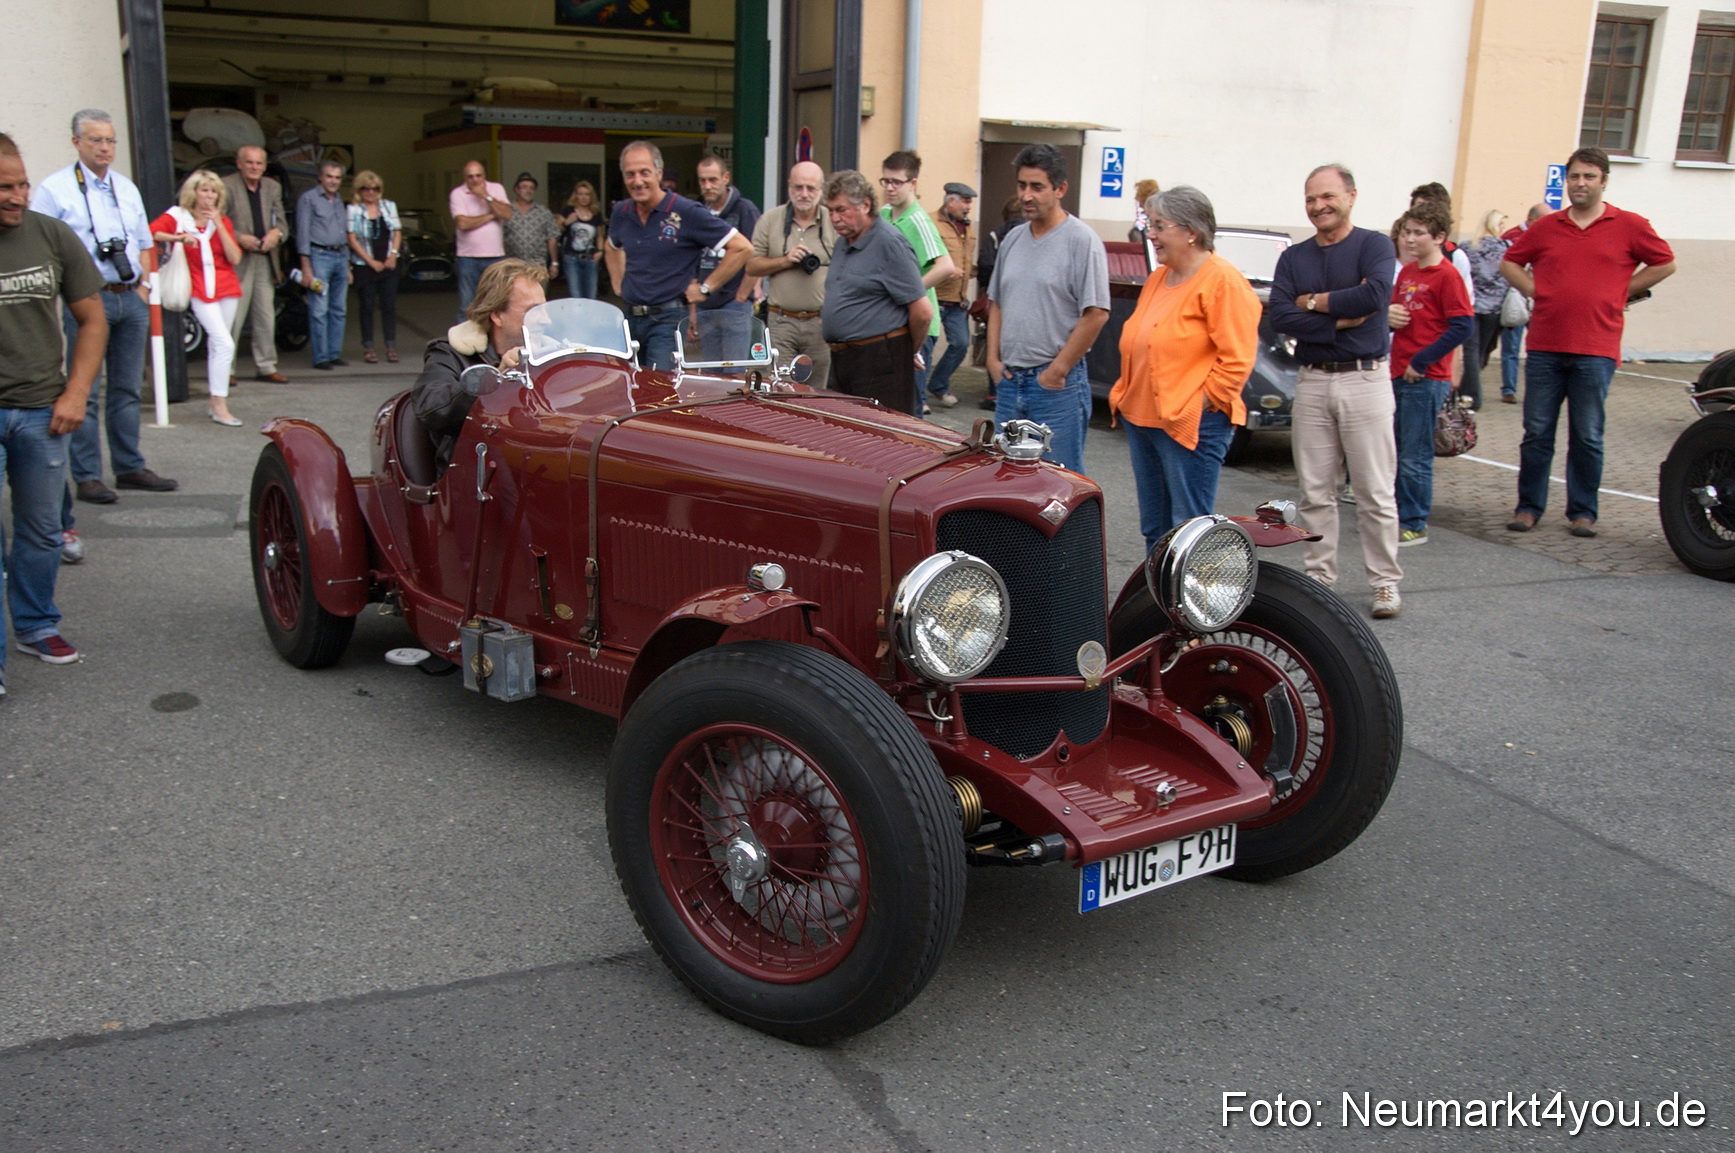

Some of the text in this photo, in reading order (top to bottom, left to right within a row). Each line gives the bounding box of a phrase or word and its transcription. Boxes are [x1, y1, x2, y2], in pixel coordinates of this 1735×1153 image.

[1103, 148, 1119, 171] P
[1547, 166, 1561, 186] P
[1104, 824, 1234, 898] WUG F9H
[1087, 889, 1096, 902] D
